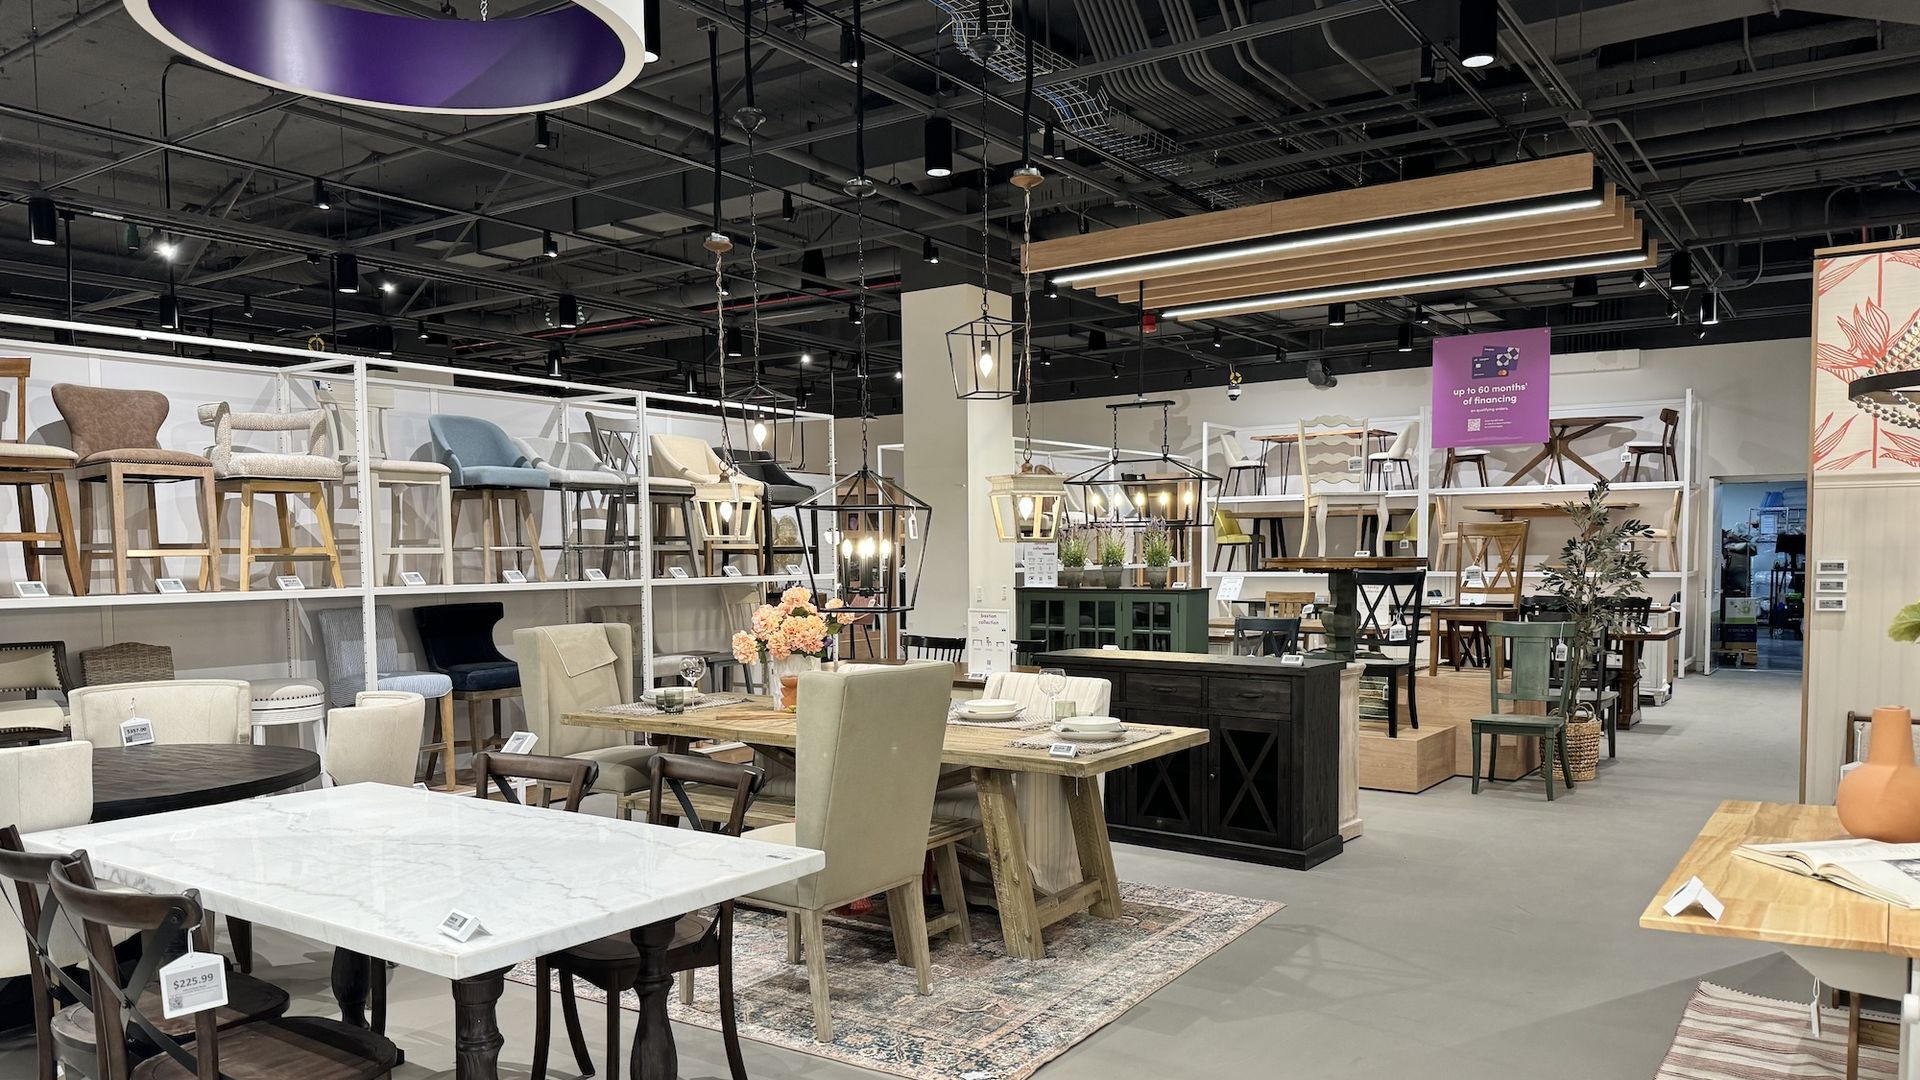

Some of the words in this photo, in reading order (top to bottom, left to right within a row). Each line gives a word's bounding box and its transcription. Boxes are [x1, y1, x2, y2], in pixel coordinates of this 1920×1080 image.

[1453, 389, 1465, 397] up
[1467, 387, 1476, 395] to
[1478, 386, 1490, 394] 60
[1463, 397, 1473, 405] of
[1474, 395, 1517, 404] financing
[173, 973, 214, 990] $225.99
